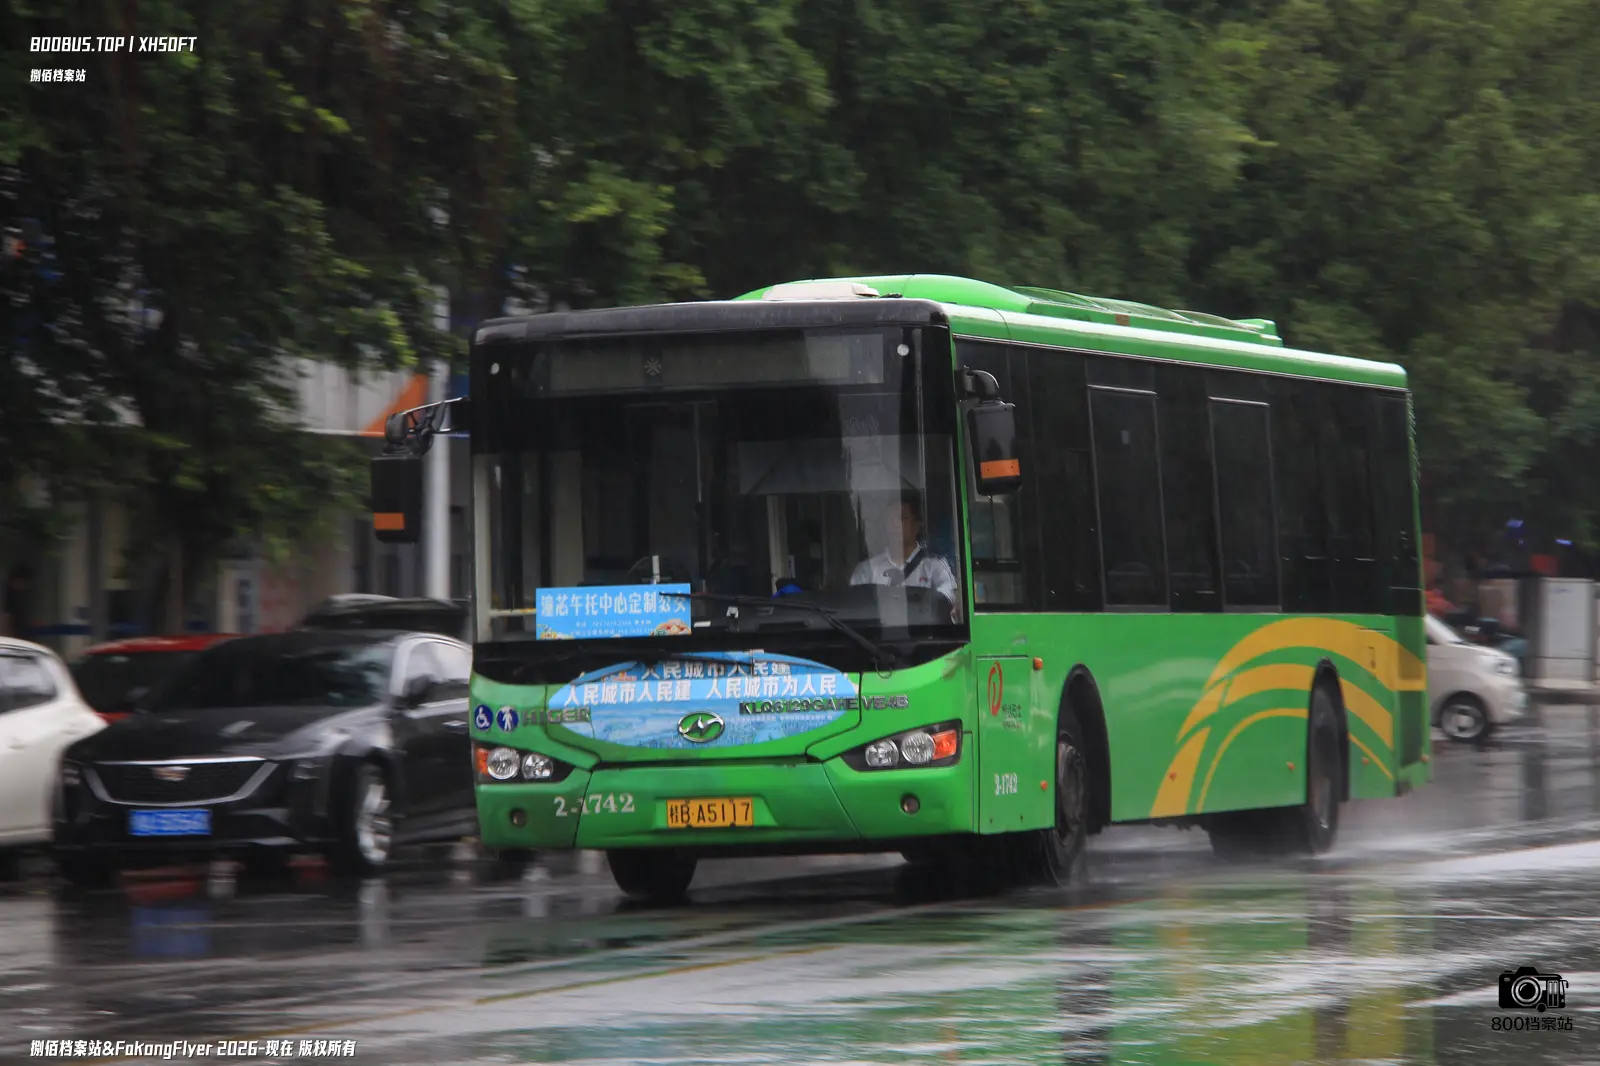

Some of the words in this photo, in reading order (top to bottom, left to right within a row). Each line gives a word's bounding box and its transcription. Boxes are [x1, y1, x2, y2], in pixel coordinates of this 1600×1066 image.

[563, 679, 692, 706] 人民城市人民建
[705, 673, 837, 700] 人民城市为人民
[522, 706, 590, 728] HIGER
[553, 793, 636, 817] 2-1742
